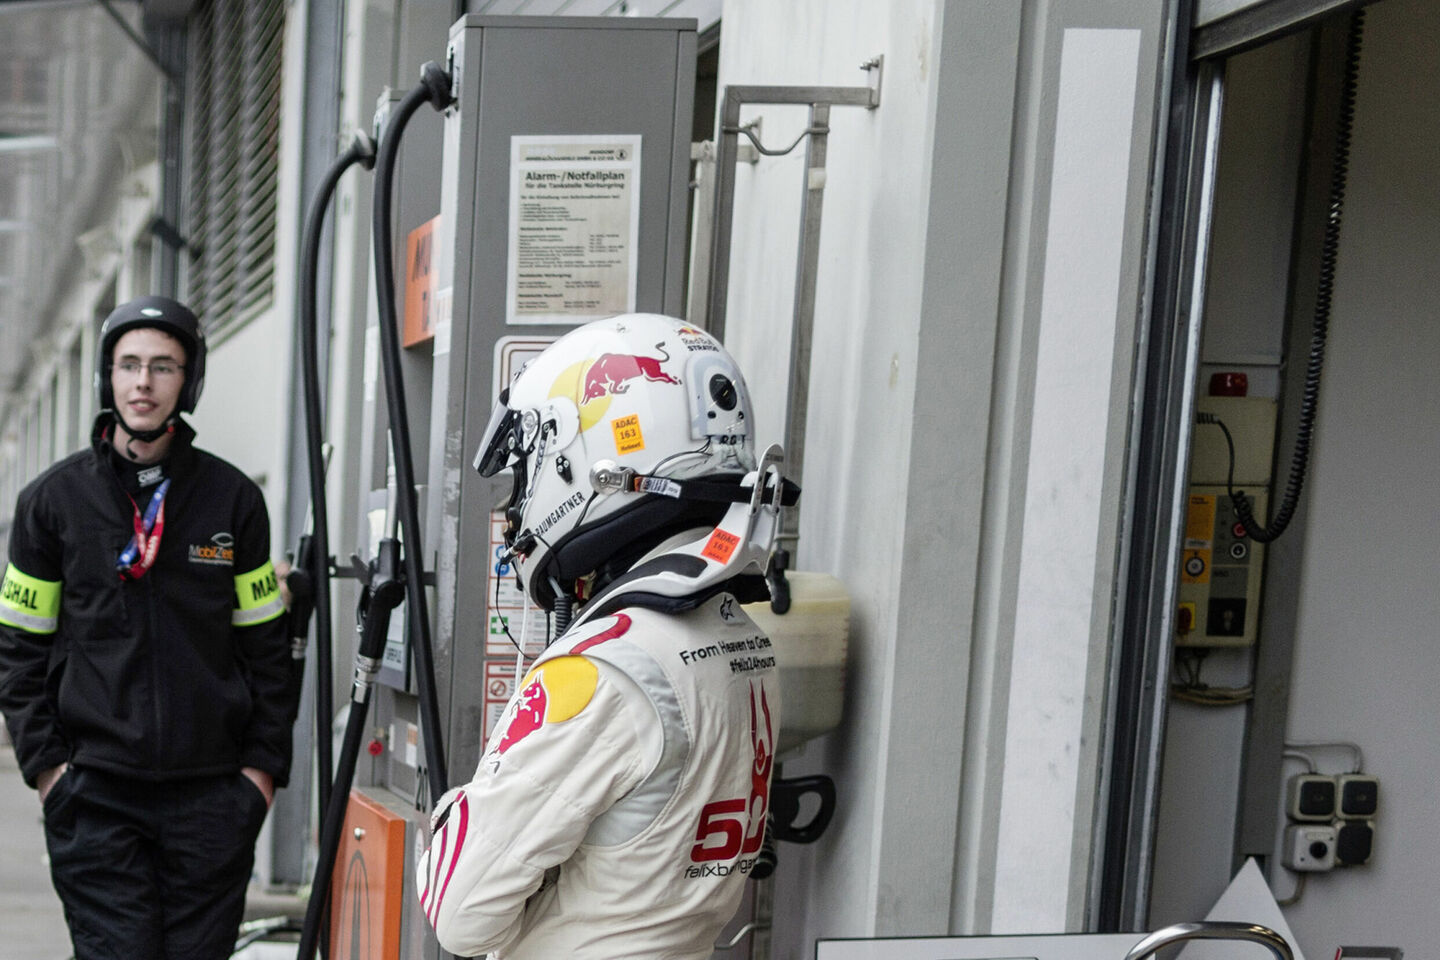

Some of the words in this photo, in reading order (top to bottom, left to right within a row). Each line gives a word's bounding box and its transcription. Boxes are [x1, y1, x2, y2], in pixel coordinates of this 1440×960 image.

[615, 417, 637, 429] ADAC
[620, 430, 636, 440] 163
[679, 644, 720, 666] From
[718, 639, 746, 655] Heaven
[745, 638, 755, 650] to
[729, 655, 777, 674] #felix24hours
